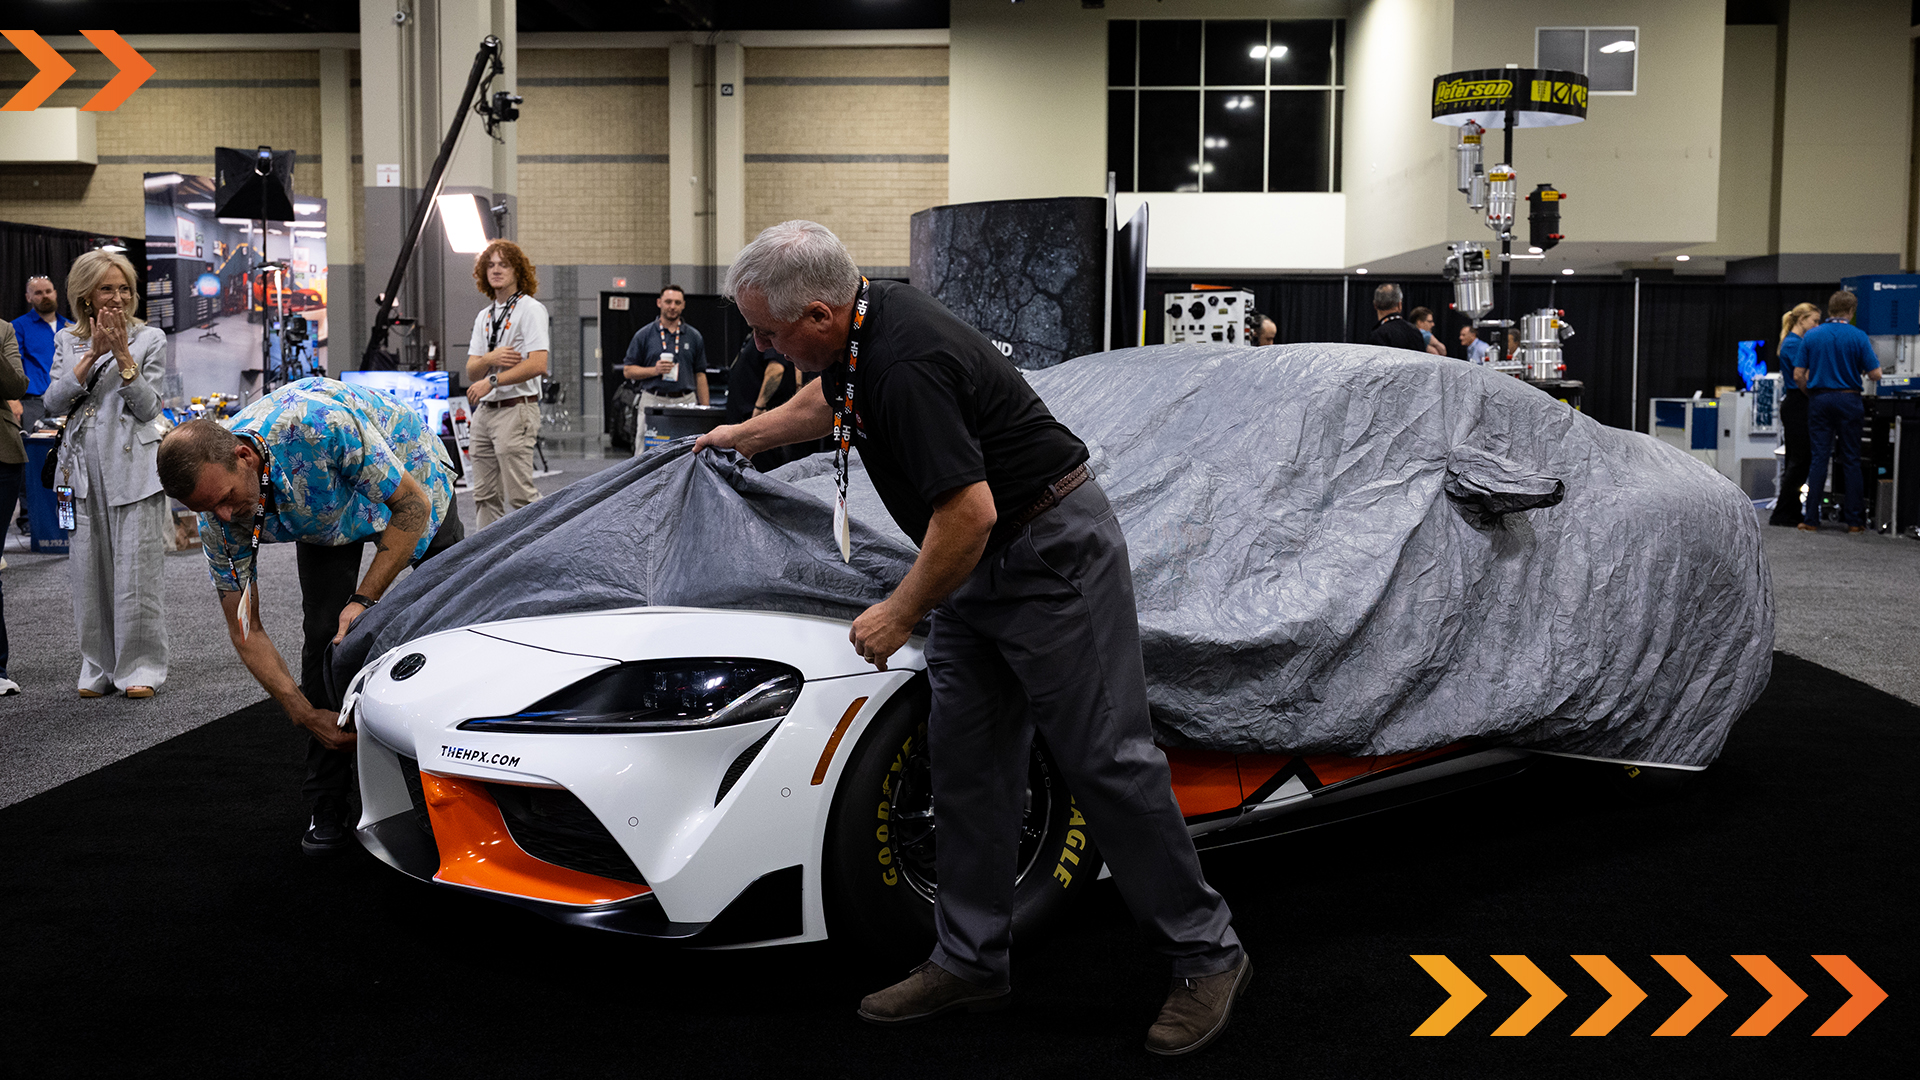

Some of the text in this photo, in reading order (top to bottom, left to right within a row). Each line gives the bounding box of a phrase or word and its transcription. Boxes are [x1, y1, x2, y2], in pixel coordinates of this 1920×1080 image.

[1436, 80, 1511, 103] Peterson
[1453, 99, 1506, 108] SYSTEMS
[853, 299, 869, 330] HPX
[849, 341, 859, 372] HPX
[844, 383, 855, 415] HPX
[833, 411, 843, 441] HPX
[840, 424, 851, 456] HPX
[261, 461, 271, 486] HPX
[256, 492, 266, 517] HPX
[251, 524, 261, 548] HPX
[441, 745, 521, 767] THEHPX.COM
[875, 720, 928, 888] GOODYEA
[1052, 793, 1088, 889] AGLE
